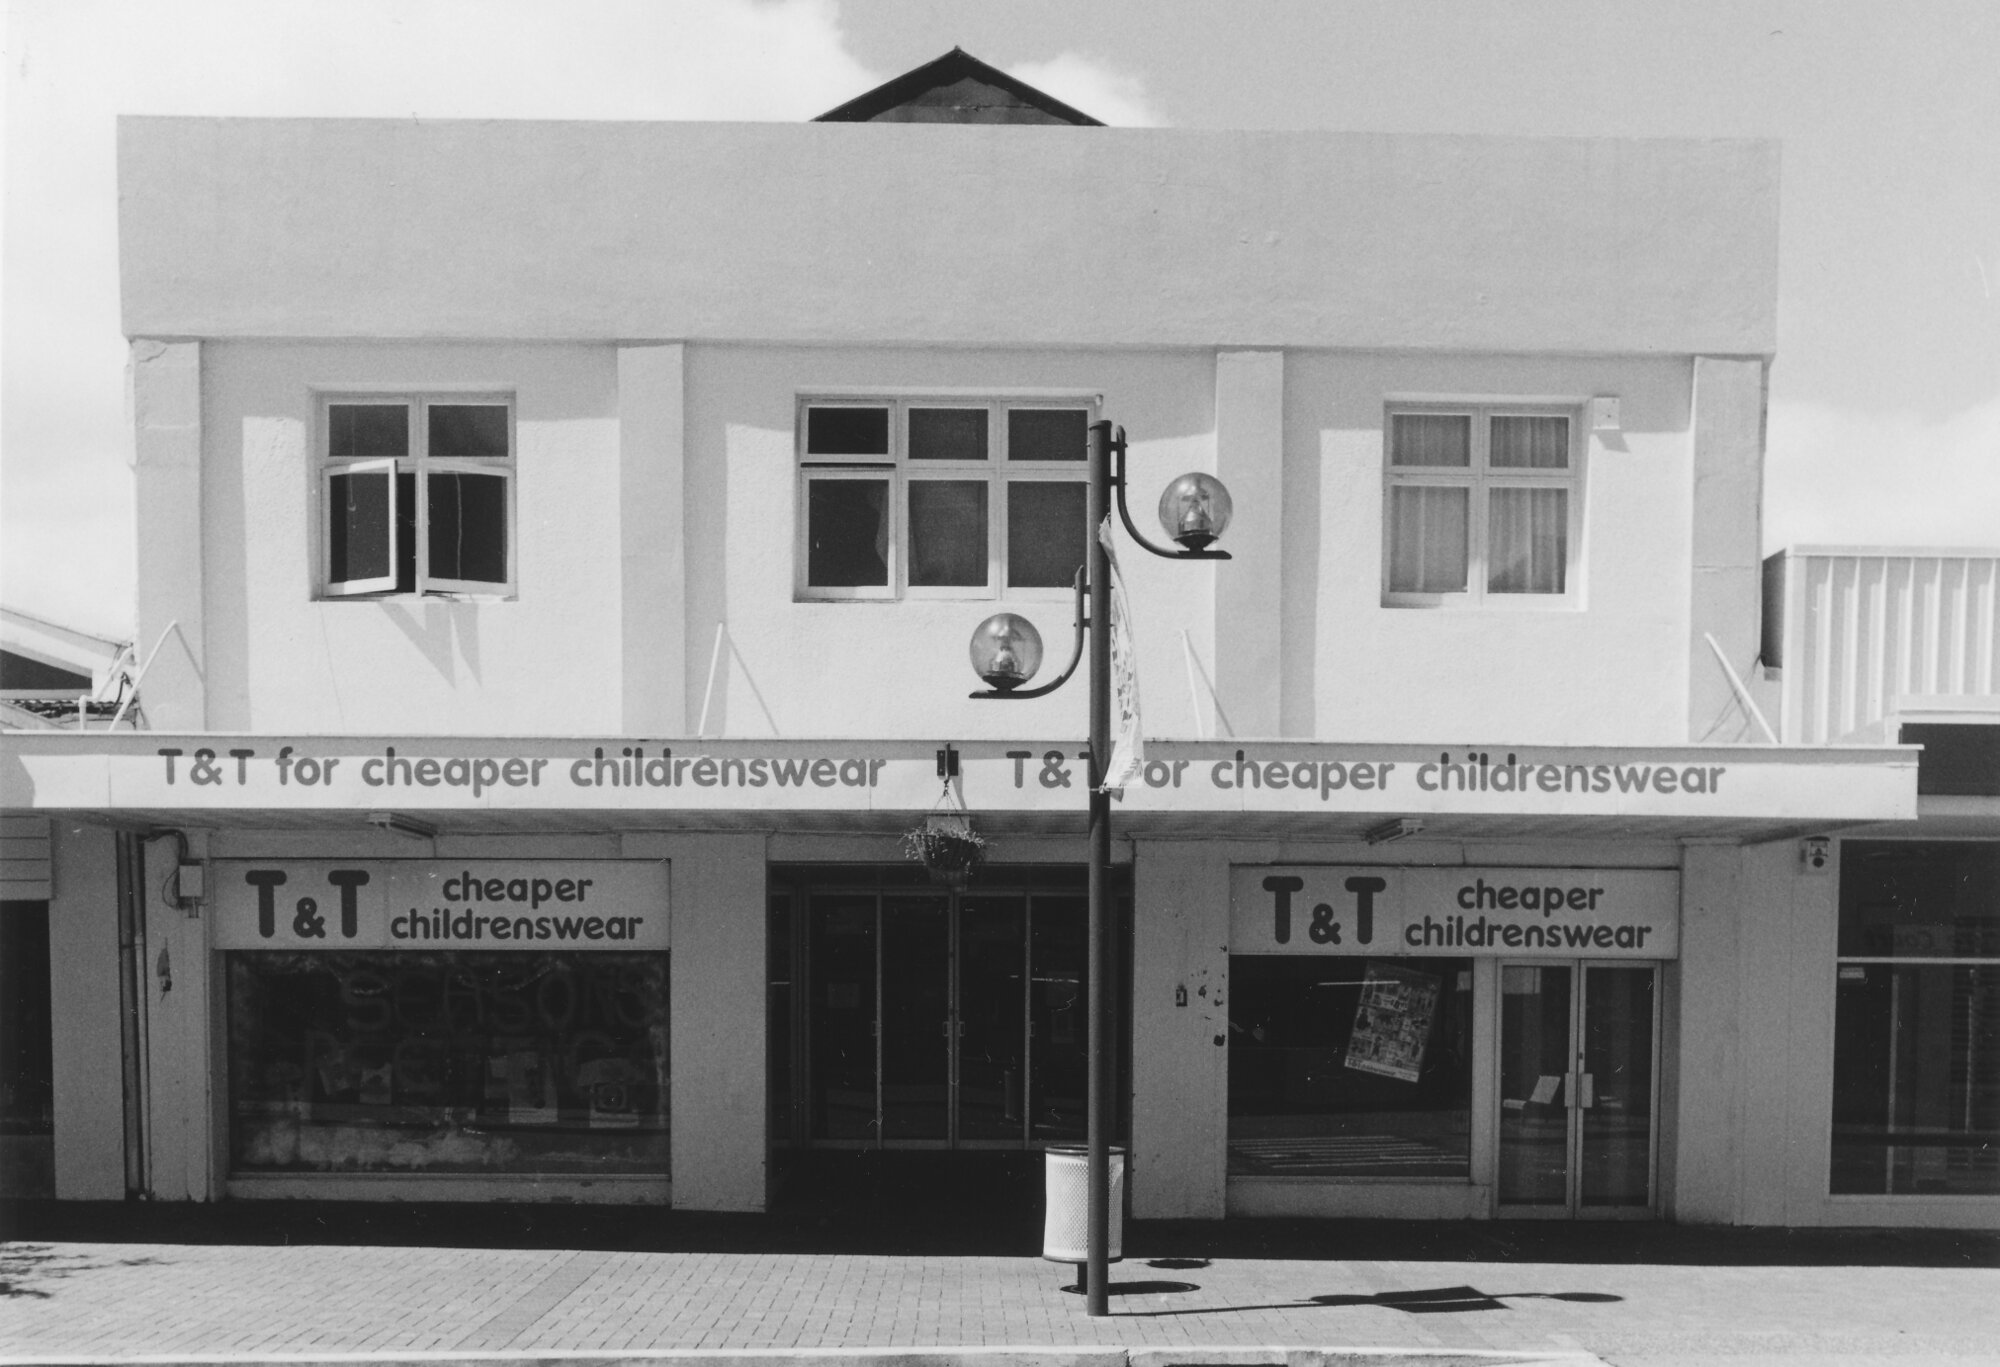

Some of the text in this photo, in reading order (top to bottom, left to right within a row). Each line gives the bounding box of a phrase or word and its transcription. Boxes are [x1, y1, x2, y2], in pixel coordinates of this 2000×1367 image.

[158, 747, 887, 798] T&T for cheaper childrenswear
[1144, 760, 1190, 789] or
[1211, 750, 1395, 801] cheaper
[1417, 752, 1726, 794] childrenswear
[245, 870, 370, 939] T&T
[443, 871, 593, 910] cheaper
[1262, 876, 1387, 945] T&T
[1458, 878, 1604, 918] cheaper
[391, 909, 644, 940] childrenswear
[1406, 916, 1652, 949] childrenswear
